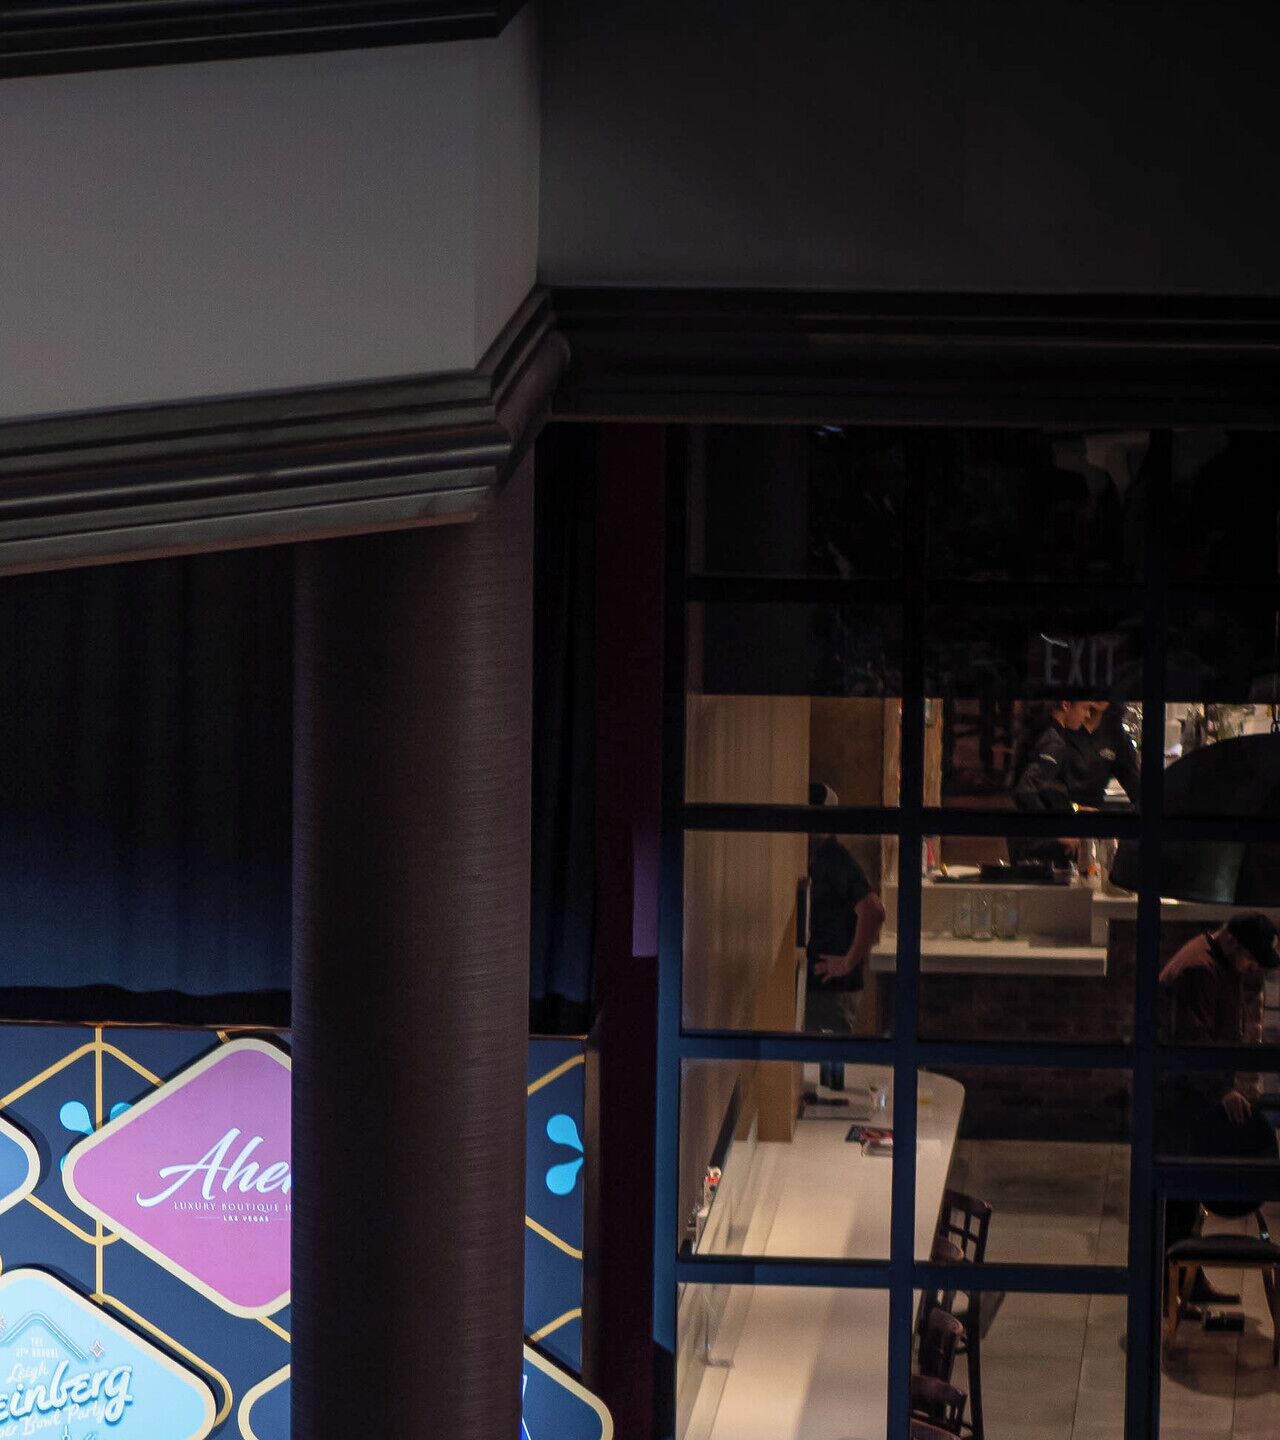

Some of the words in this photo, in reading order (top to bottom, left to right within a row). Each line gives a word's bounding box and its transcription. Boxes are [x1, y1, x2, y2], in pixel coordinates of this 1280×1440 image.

[1043, 636, 1120, 687] EXIT
[136, 1127, 291, 1207] Ahe
[174, 1201, 216, 1210] LUXURY
[221, 1203, 279, 1212] BOUTIQUE
[6, 1361, 49, 1383] Leigh
[21, 1411, 61, 1436] Bowl
[66, 1403, 106, 1423] Party
